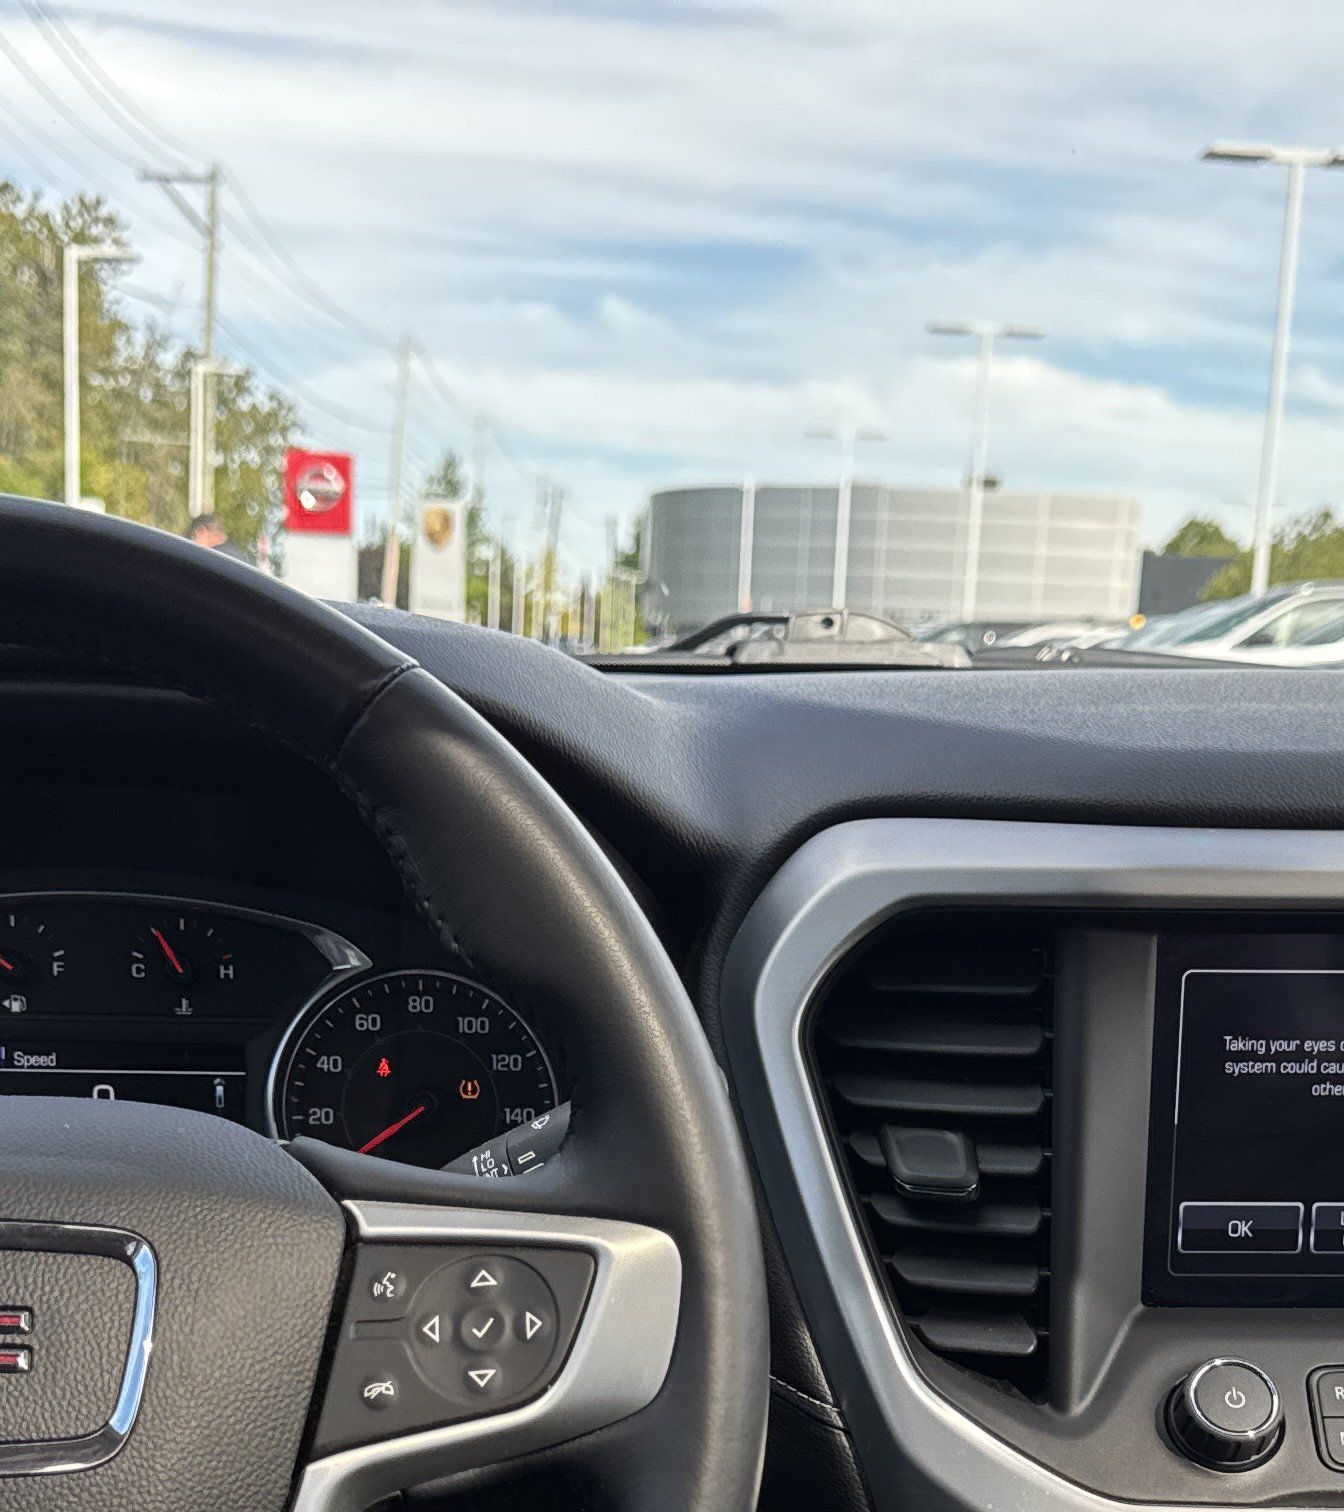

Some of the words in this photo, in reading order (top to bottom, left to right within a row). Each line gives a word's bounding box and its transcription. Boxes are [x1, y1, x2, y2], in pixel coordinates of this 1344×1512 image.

[52, 961, 65, 977] F
[131, 963, 146, 978] C
[219, 964, 234, 979] H
[407, 995, 434, 1013] 80
[355, 1013, 381, 1031] 60
[457, 1016, 490, 1034] 100
[1223, 1035, 1266, 1055] Taking
[1269, 1039, 1301, 1055] your
[1303, 1039, 1336, 1055] eyes
[12, 1051, 57, 1069] Speed
[315, 1055, 343, 1073] 40
[491, 1054, 522, 1071] 120
[1224, 1060, 1276, 1077] system
[1280, 1058, 1318, 1074] could
[308, 1107, 334, 1125] 20
[504, 1107, 536, 1125] 140
[480, 1149, 491, 1162] HI
[481, 1158, 495, 1173] LO
[1227, 1219, 1254, 1238] OK
